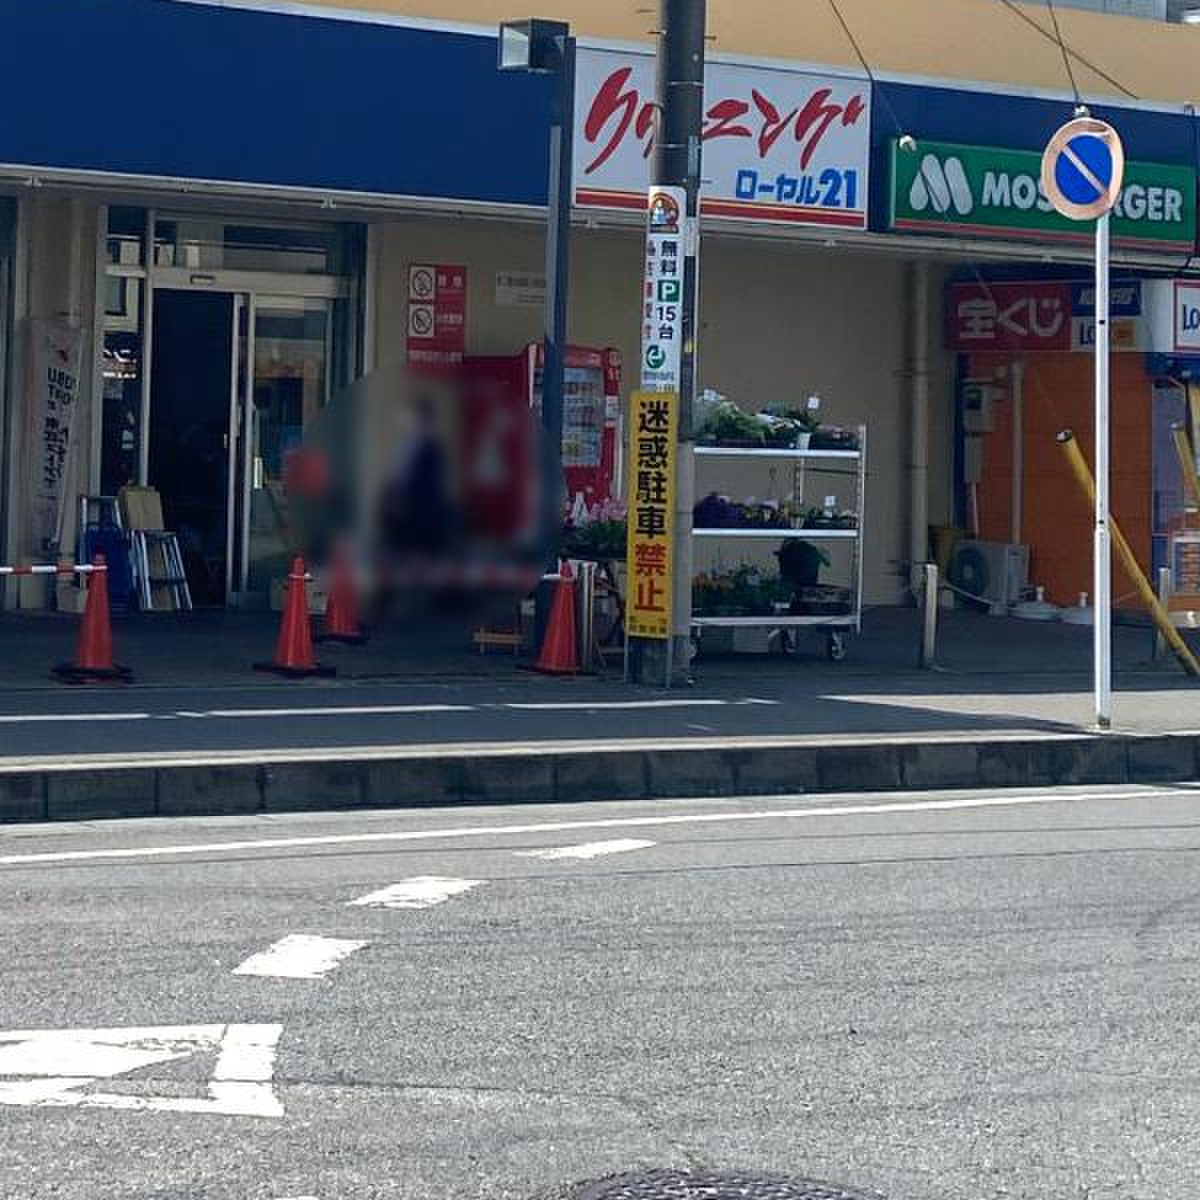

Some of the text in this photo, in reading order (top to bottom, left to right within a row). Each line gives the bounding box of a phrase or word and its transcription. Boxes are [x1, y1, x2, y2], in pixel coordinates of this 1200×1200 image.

[584, 66, 866, 174] クニング
[736, 167, 858, 209] ローヤル21
[1112, 182, 1184, 223] GER
[957, 297, 1063, 341] 宝くじ
[634, 400, 669, 612] 迷惑駐車禁止
